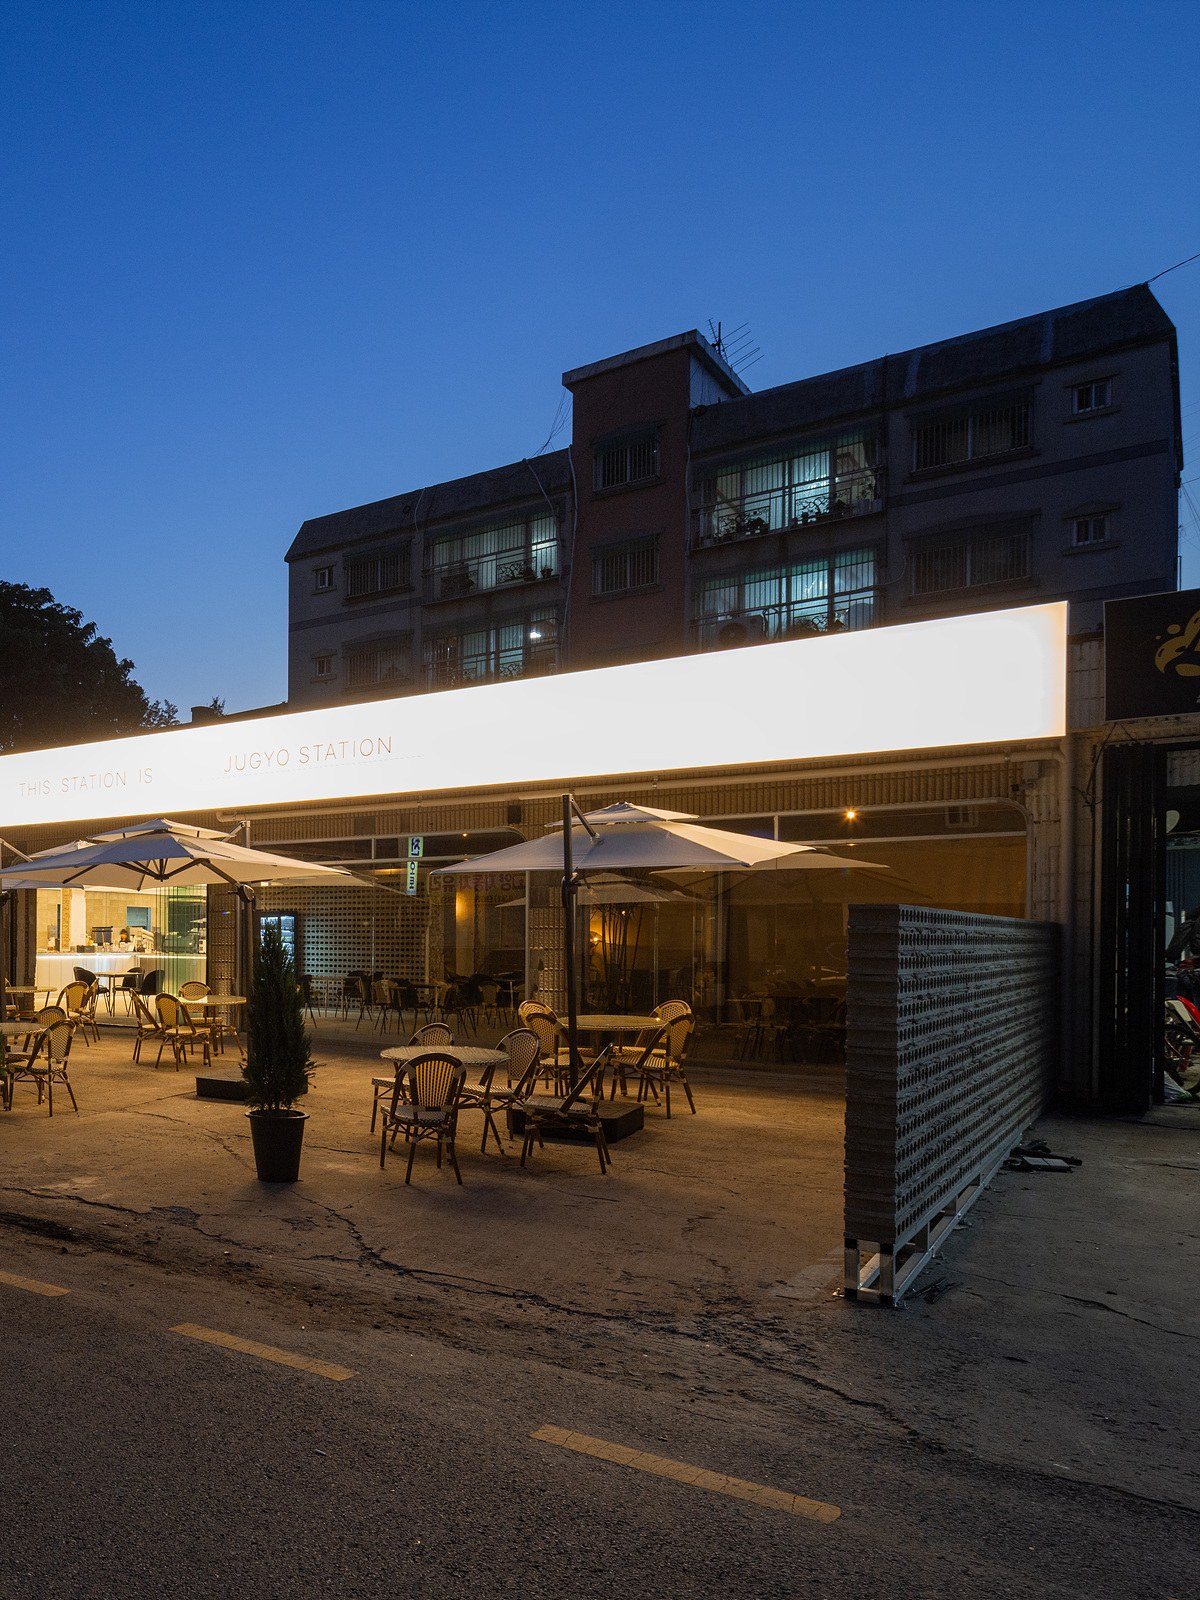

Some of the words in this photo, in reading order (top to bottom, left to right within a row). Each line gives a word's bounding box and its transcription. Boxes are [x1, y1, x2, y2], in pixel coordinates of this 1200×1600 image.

[19, 779, 51, 797] THIS
[60, 771, 127, 793] STATION
[138, 767, 153, 784] IS
[223, 748, 289, 774] JUGYO
[299, 735, 392, 764] STATION
